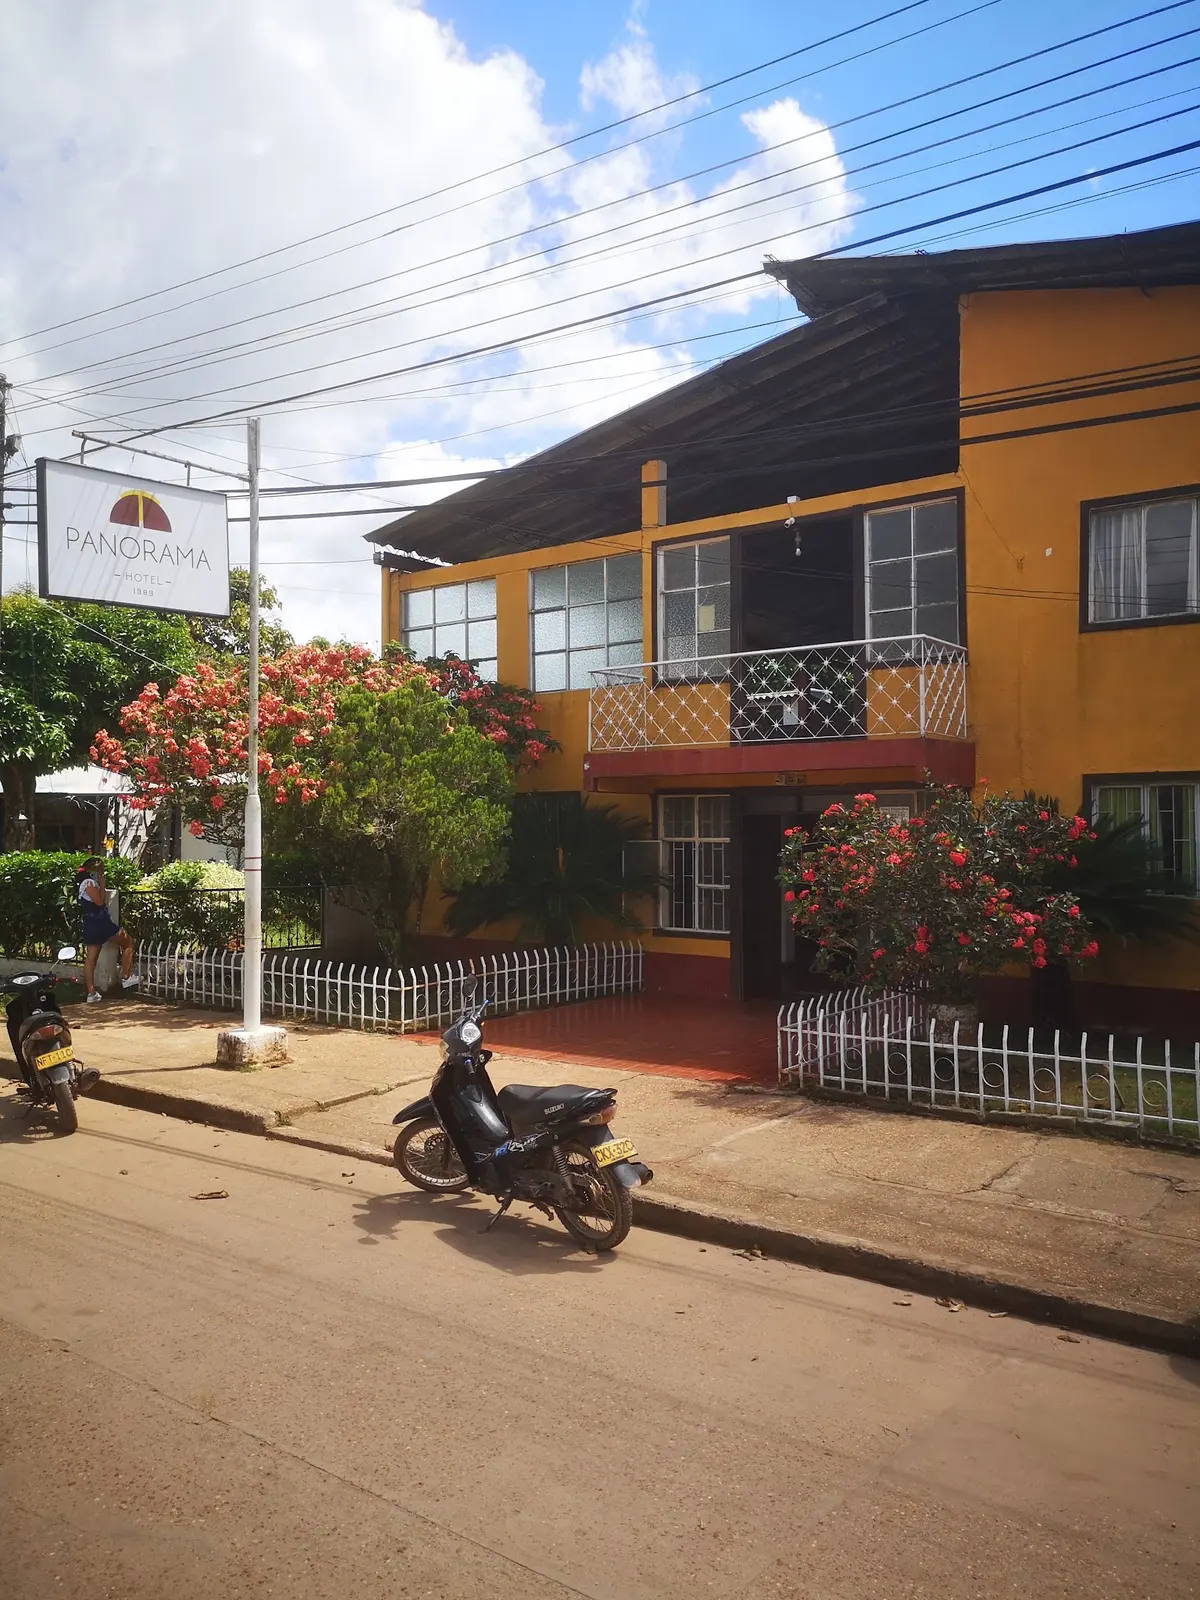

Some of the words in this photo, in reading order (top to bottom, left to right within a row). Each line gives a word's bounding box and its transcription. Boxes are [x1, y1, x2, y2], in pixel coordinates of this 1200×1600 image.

[66, 527, 212, 571] PANORAMA
[125, 572, 163, 586] HOTEL
[544, 1103, 565, 1115] SUZUKI
